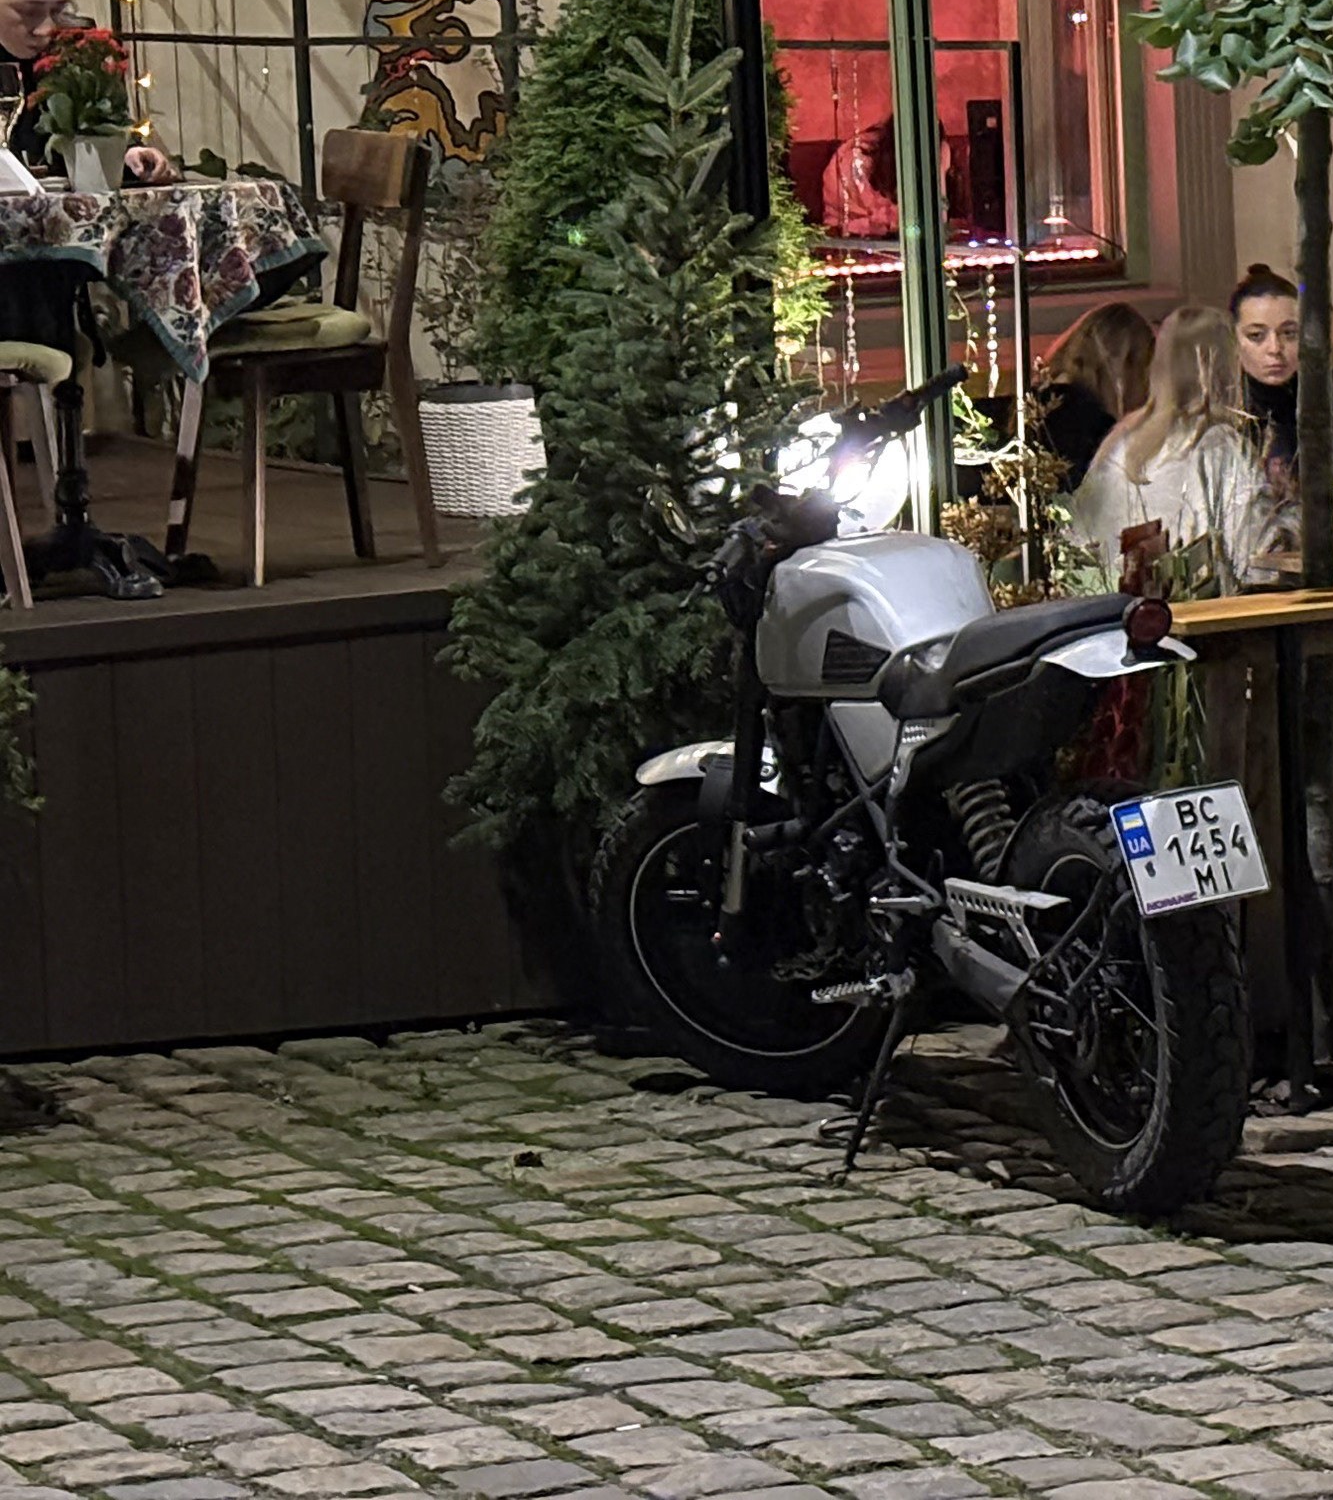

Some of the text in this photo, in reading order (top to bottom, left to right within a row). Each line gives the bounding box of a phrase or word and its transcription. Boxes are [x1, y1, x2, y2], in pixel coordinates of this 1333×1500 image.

[1175, 796, 1219, 829] BC
[1127, 838, 1151, 854] UA
[1166, 825, 1248, 866] 1454
[1194, 862, 1232, 895] MI
